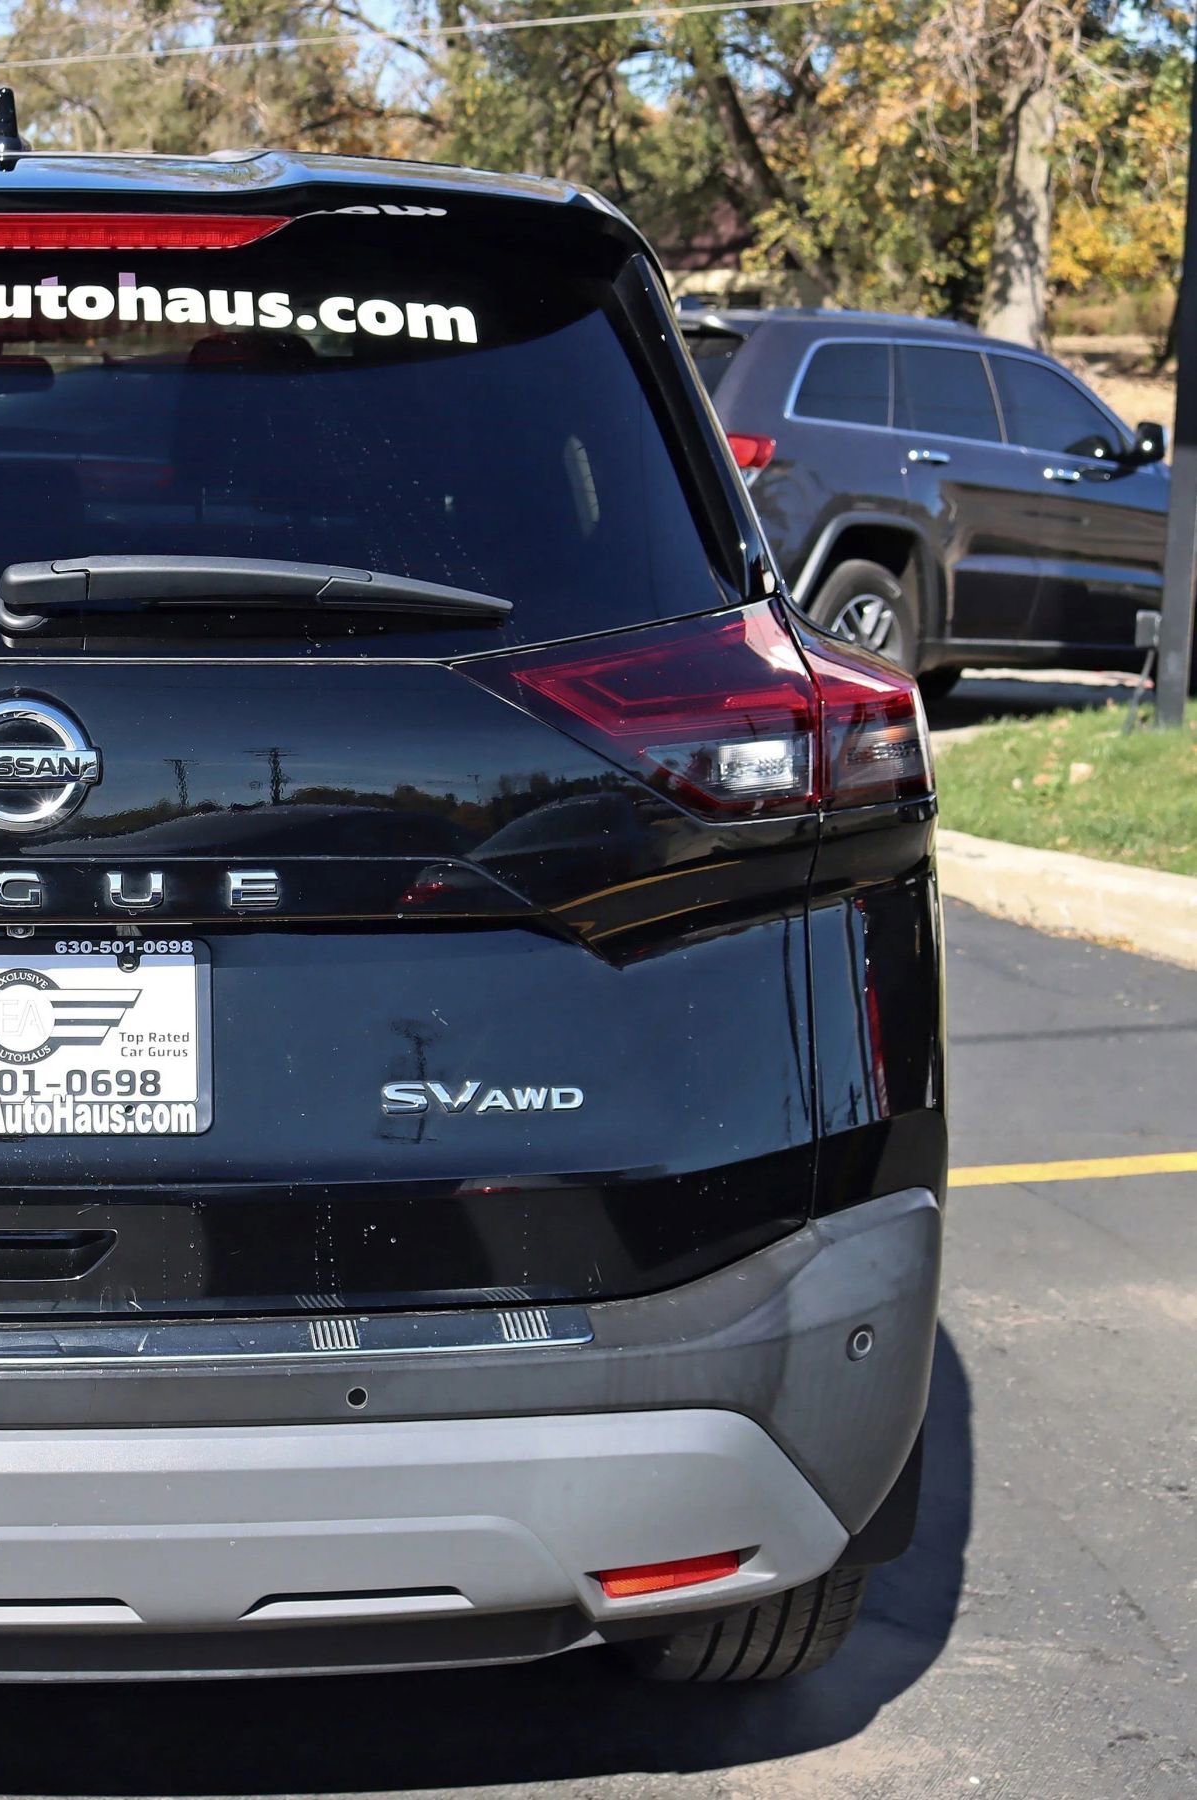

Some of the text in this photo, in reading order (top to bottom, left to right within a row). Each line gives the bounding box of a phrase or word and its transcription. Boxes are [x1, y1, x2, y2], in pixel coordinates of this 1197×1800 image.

[54, 940, 194, 954] 630-501-0698
[119, 1031, 190, 1046] Top Rated
[120, 1046, 189, 1057] Car Gurus
